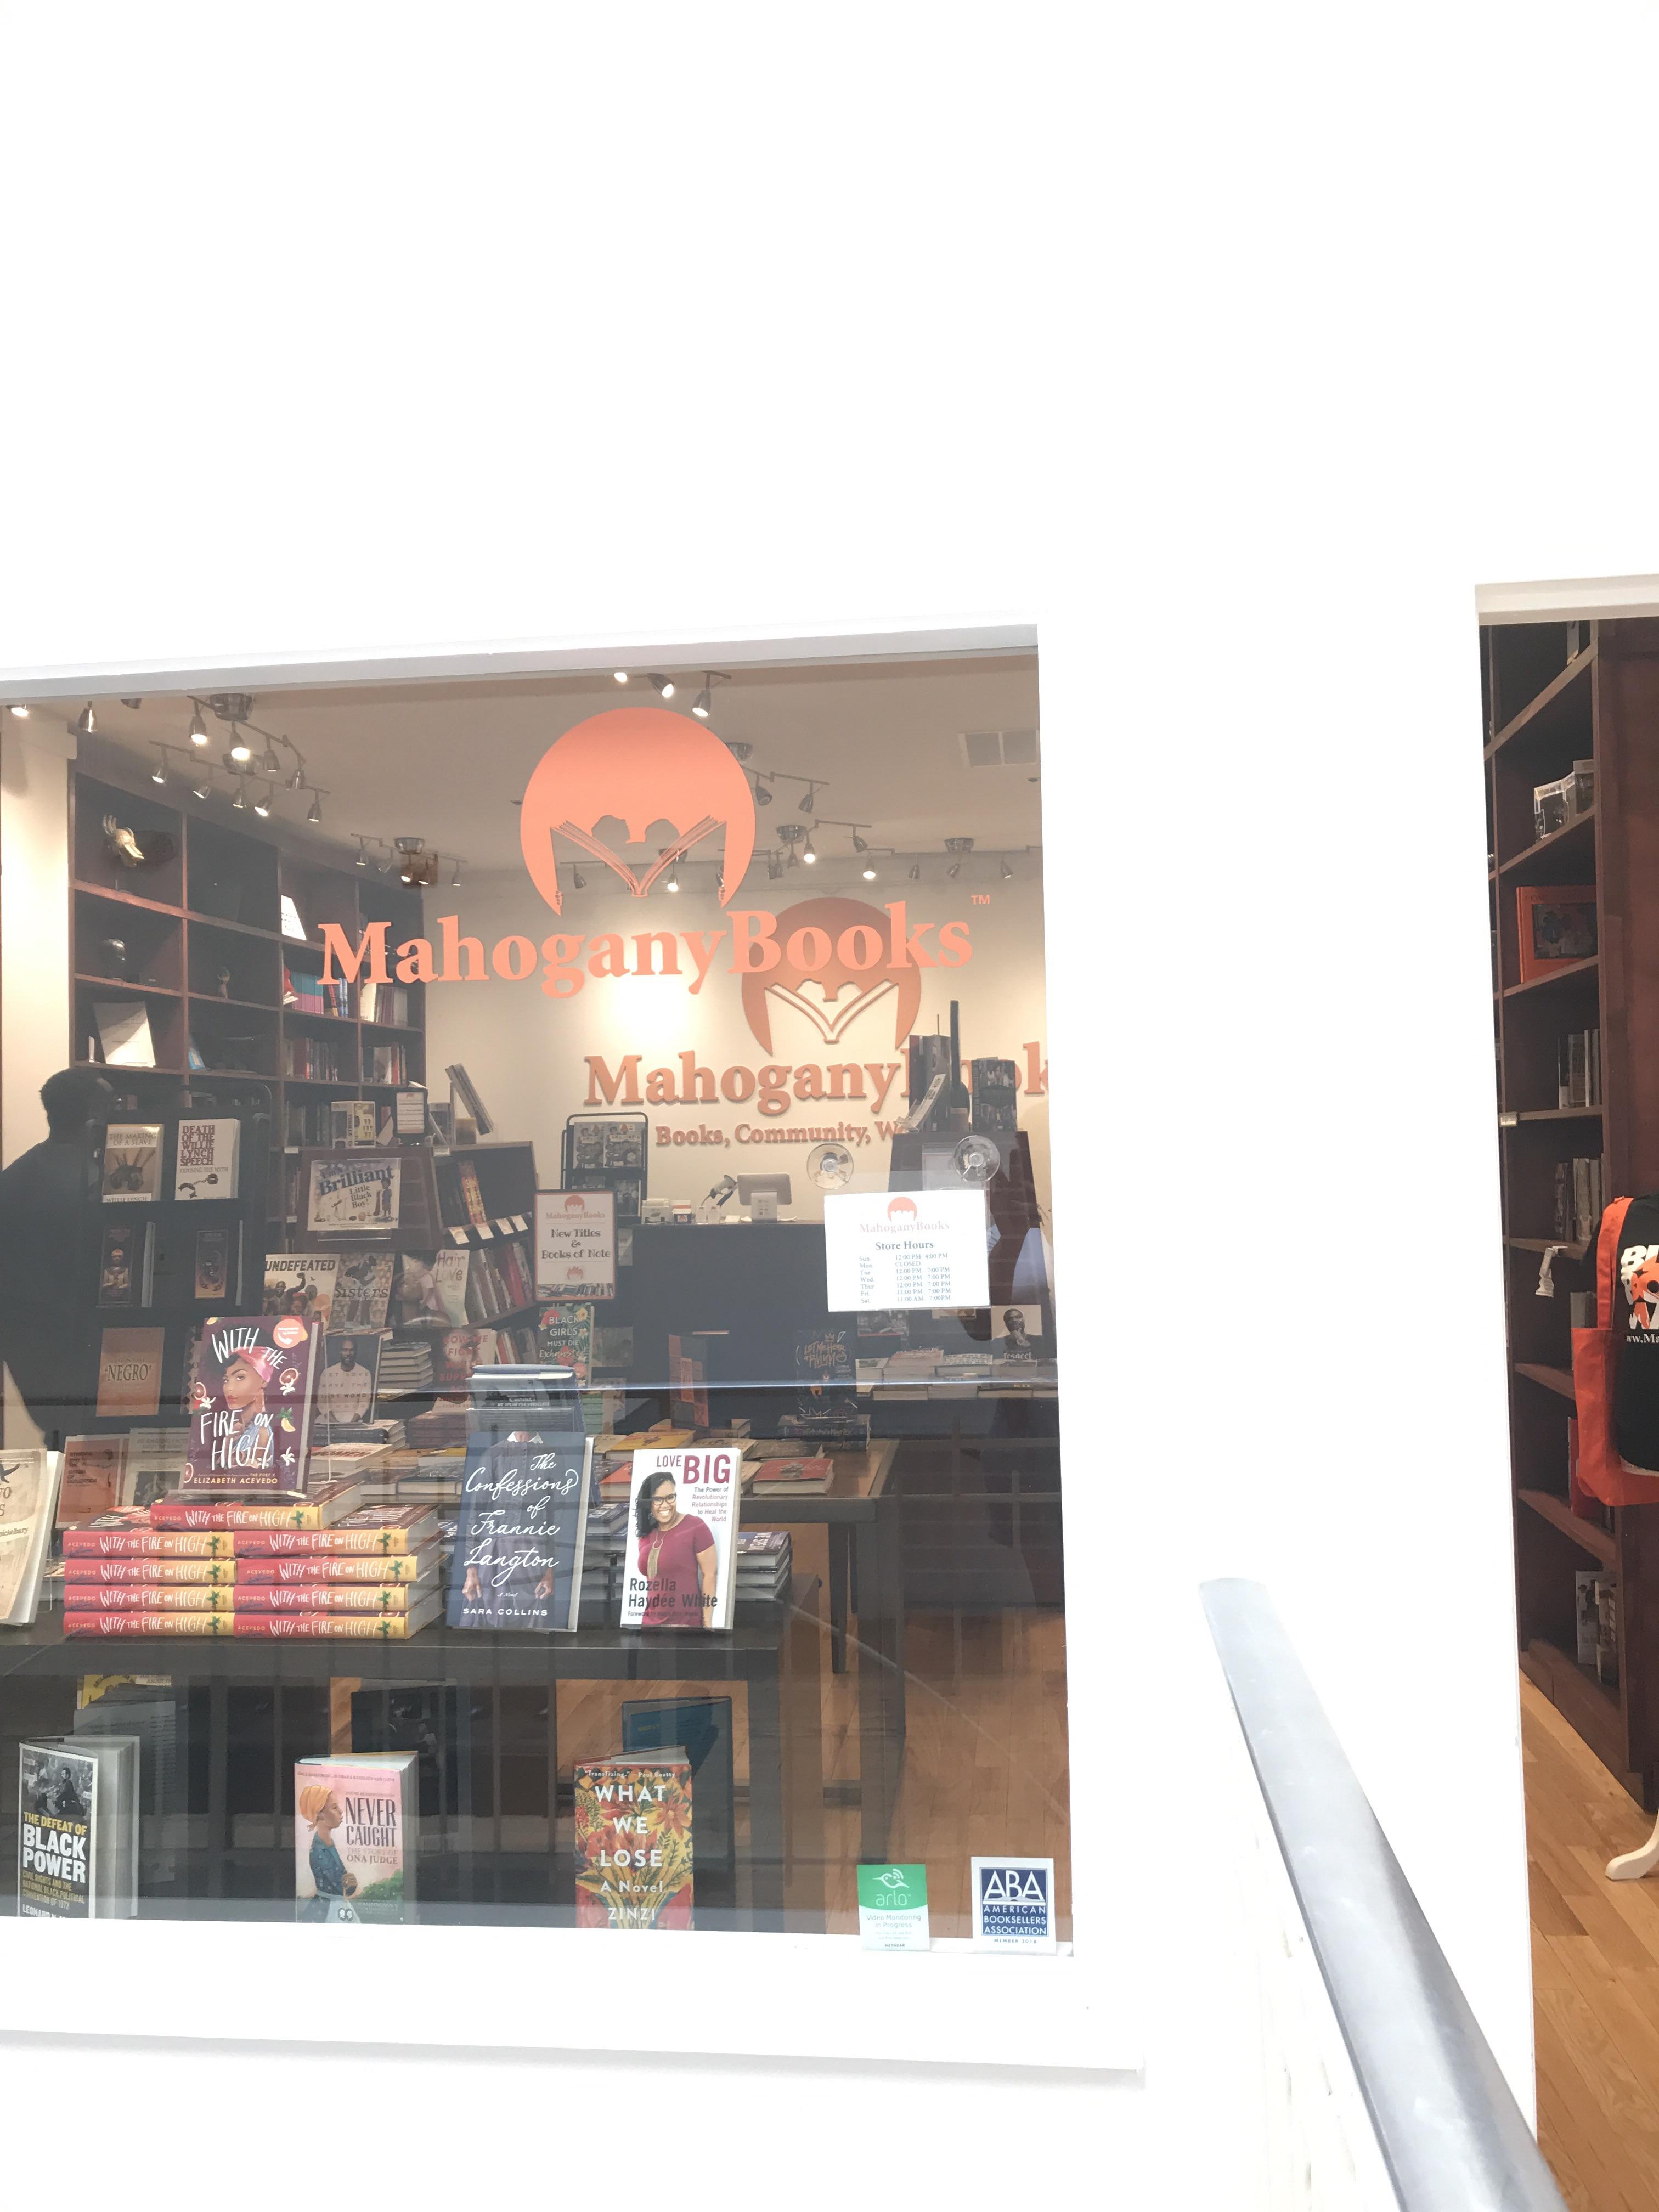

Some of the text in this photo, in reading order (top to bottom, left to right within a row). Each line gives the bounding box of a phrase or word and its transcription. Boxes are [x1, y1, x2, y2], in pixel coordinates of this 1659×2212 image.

[317, 901, 972, 998] MahoganyBooks
[183, 1125, 215, 1133] DEATH
[656, 1124, 730, 1147] Books,
[735, 1122, 871, 1146] Community,
[180, 1149, 213, 1158] LYNCH
[181, 1141, 214, 1149] WILLIE
[180, 1158, 213, 1166] SPEECH
[319, 1166, 394, 1195] Brilliant
[349, 1185, 370, 1195] Little
[351, 1192, 371, 1201] Black
[551, 1229, 601, 1238] New Titles
[860, 1221, 949, 1234] MahoganyBooks
[542, 1249, 610, 1259] Books of Note
[876, 1242, 900, 1250] Store
[265, 1260, 336, 1271] UNDEFEATED
[438, 1252, 465, 1267] Hair
[550, 1328, 578, 1336] GIRLS
[212, 1328, 287, 1369] WITH THE
[201, 1410, 273, 1444] FIRE ON
[211, 1432, 273, 1470] HIGH
[530, 1453, 556, 1471] The
[656, 1454, 731, 1484] LOVE BIG
[465, 1466, 579, 1500] Confessions
[527, 1496, 552, 1519] of
[185, 1510, 211, 1526] WITH
[226, 1511, 249, 1526] FIRE
[260, 1511, 292, 1527] HIGH
[471, 1510, 561, 1536] Frannie
[269, 1534, 296, 1551] WITH
[296, 1538, 309, 1546] THE
[312, 1534, 335, 1550] FIRE
[345, 1533, 378, 1551] HIGH
[463, 1538, 559, 1587] Langton
[630, 1578, 676, 1591] Rozella
[629, 1594, 718, 1610] Haydée White
[595, 1785, 666, 1802] WHAT
[345, 1797, 396, 1826] NEVER
[24, 1812, 87, 1835] THE DEFEAT OF
[613, 1817, 648, 1834] WE
[24, 1824, 86, 1860] BLACK
[346, 1826, 397, 1847] CAUGHT
[23, 1847, 85, 1883] POWER
[369, 1855, 398, 1864] JUDGE
[600, 1849, 663, 1866] LOSE
[600, 1881, 663, 1892] A Novel
[983, 1870, 1045, 1901] ABA
[876, 1890, 907, 1906] arlo
[608, 1908, 656, 1920] ZINZI
[984, 1905, 1046, 1914] AMERICAN
[984, 1916, 1046, 1925] BOOKSELLERS
[984, 1926, 1046, 1934] ASSOCIATION
